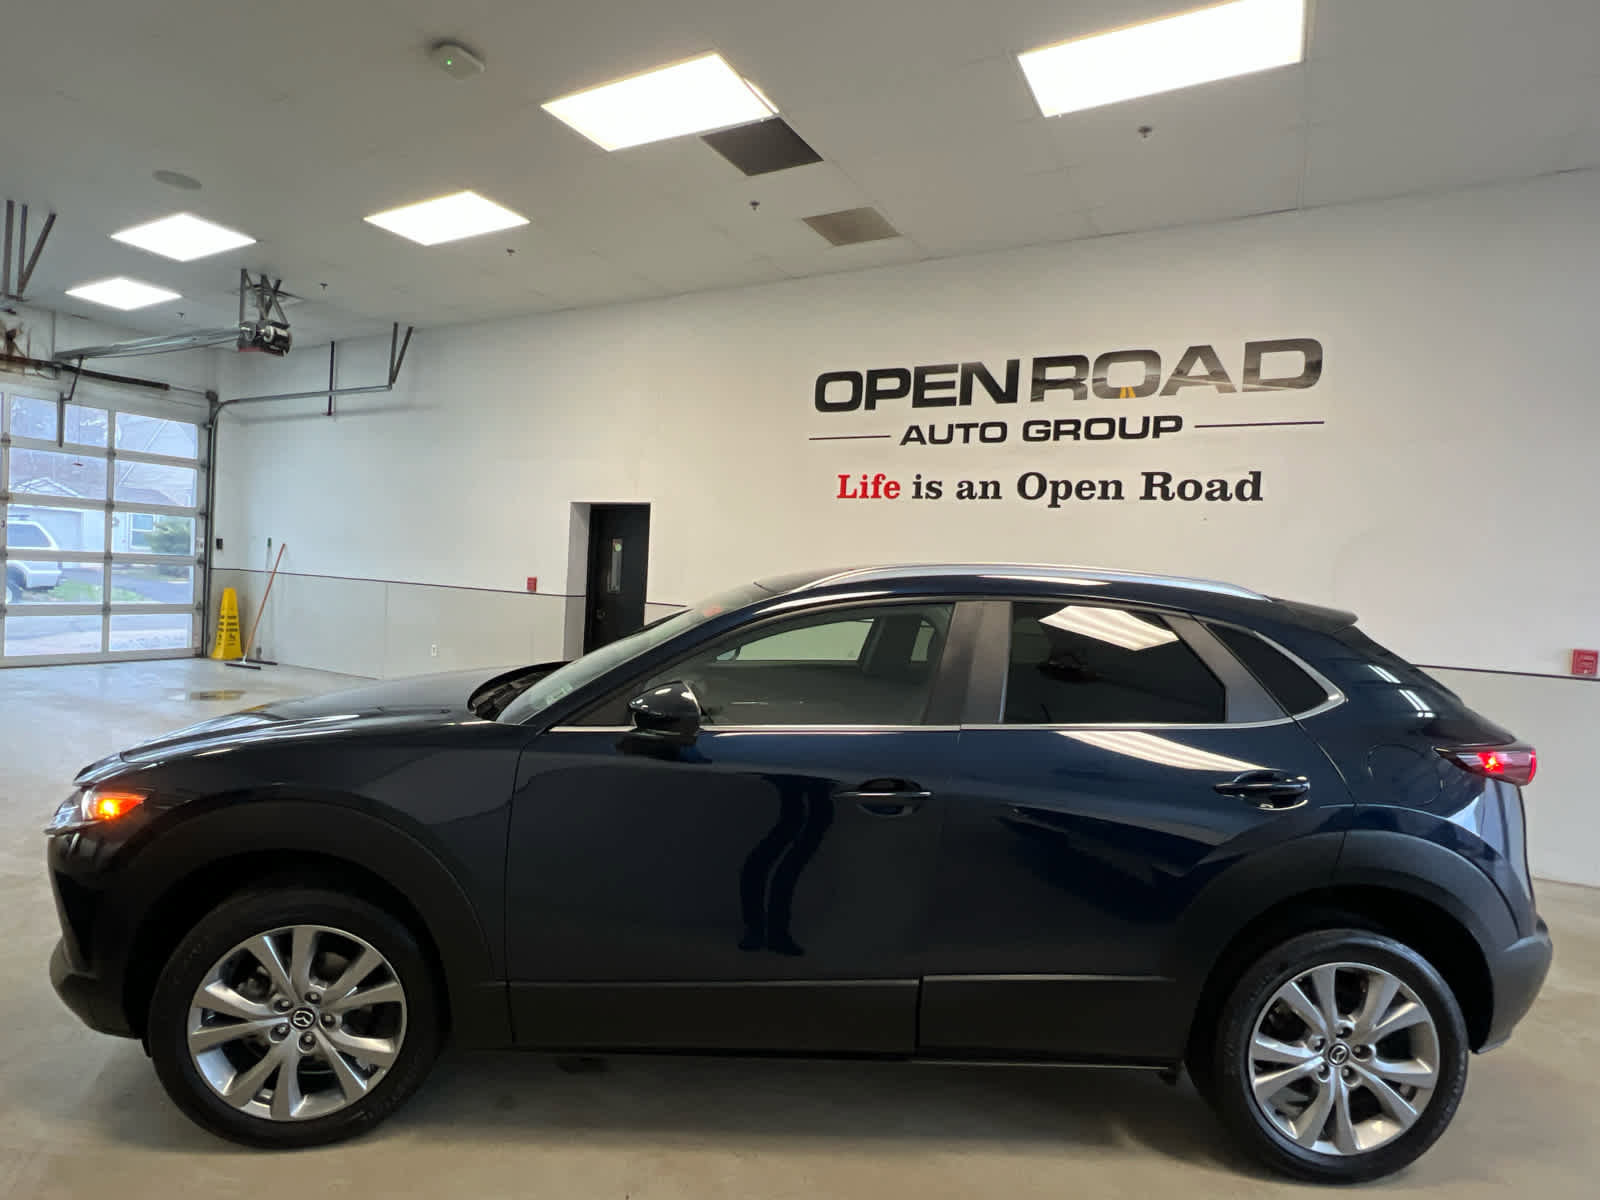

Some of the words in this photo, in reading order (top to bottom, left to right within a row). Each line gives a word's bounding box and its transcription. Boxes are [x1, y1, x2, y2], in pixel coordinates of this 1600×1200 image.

[814, 358, 1021, 414] OPEN
[1029, 337, 1324, 404] ROAD
[898, 420, 1008, 447] AUTO
[1021, 414, 1184, 444] GROUP
[835, 473, 902, 501] Life
[911, 473, 943, 501] is
[955, 479, 1003, 502] an
[1016, 471, 1126, 509] Open
[1138, 470, 1264, 503] Road
